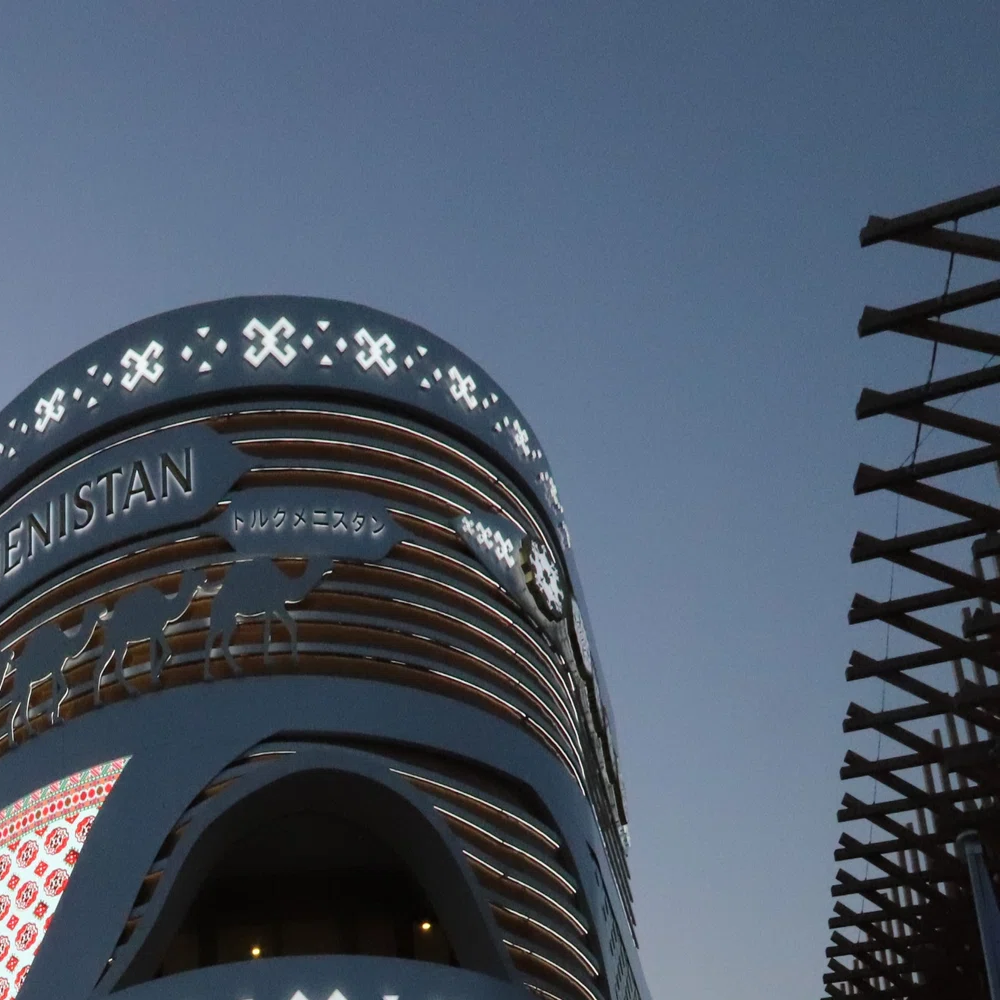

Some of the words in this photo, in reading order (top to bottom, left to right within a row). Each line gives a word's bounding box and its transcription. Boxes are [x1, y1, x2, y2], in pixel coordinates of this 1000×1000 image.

[233, 507, 386, 535] トルクメニスタン
